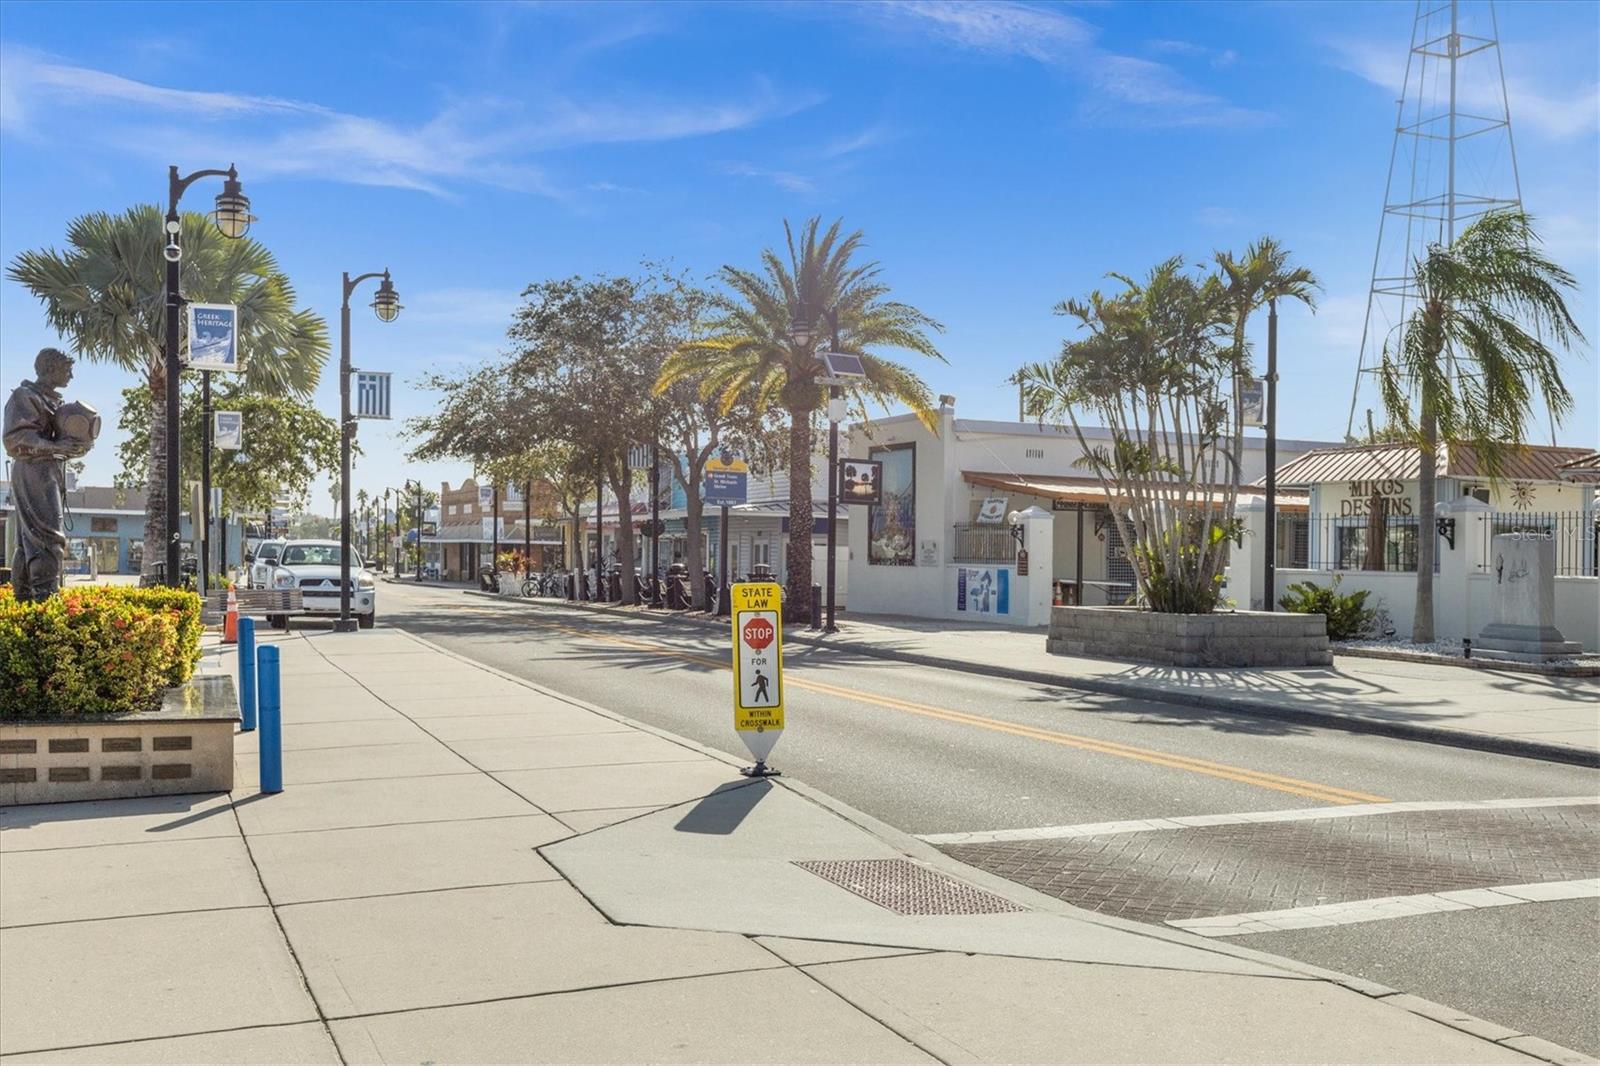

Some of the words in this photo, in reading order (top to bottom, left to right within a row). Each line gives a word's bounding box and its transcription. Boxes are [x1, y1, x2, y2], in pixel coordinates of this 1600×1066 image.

[197, 312, 220, 320] GREEK
[197, 320, 233, 328] HERITAGE
[1350, 480, 1404, 497] MIKOS
[1341, 497, 1412, 517] DESNS
[742, 588, 772, 598] STATE
[747, 599, 768, 608] LAW
[745, 627, 772, 640] STOP
[751, 657, 767, 665] FOR
[749, 710, 772, 718] WITHIN
[740, 719, 780, 728] CROSSWALK
